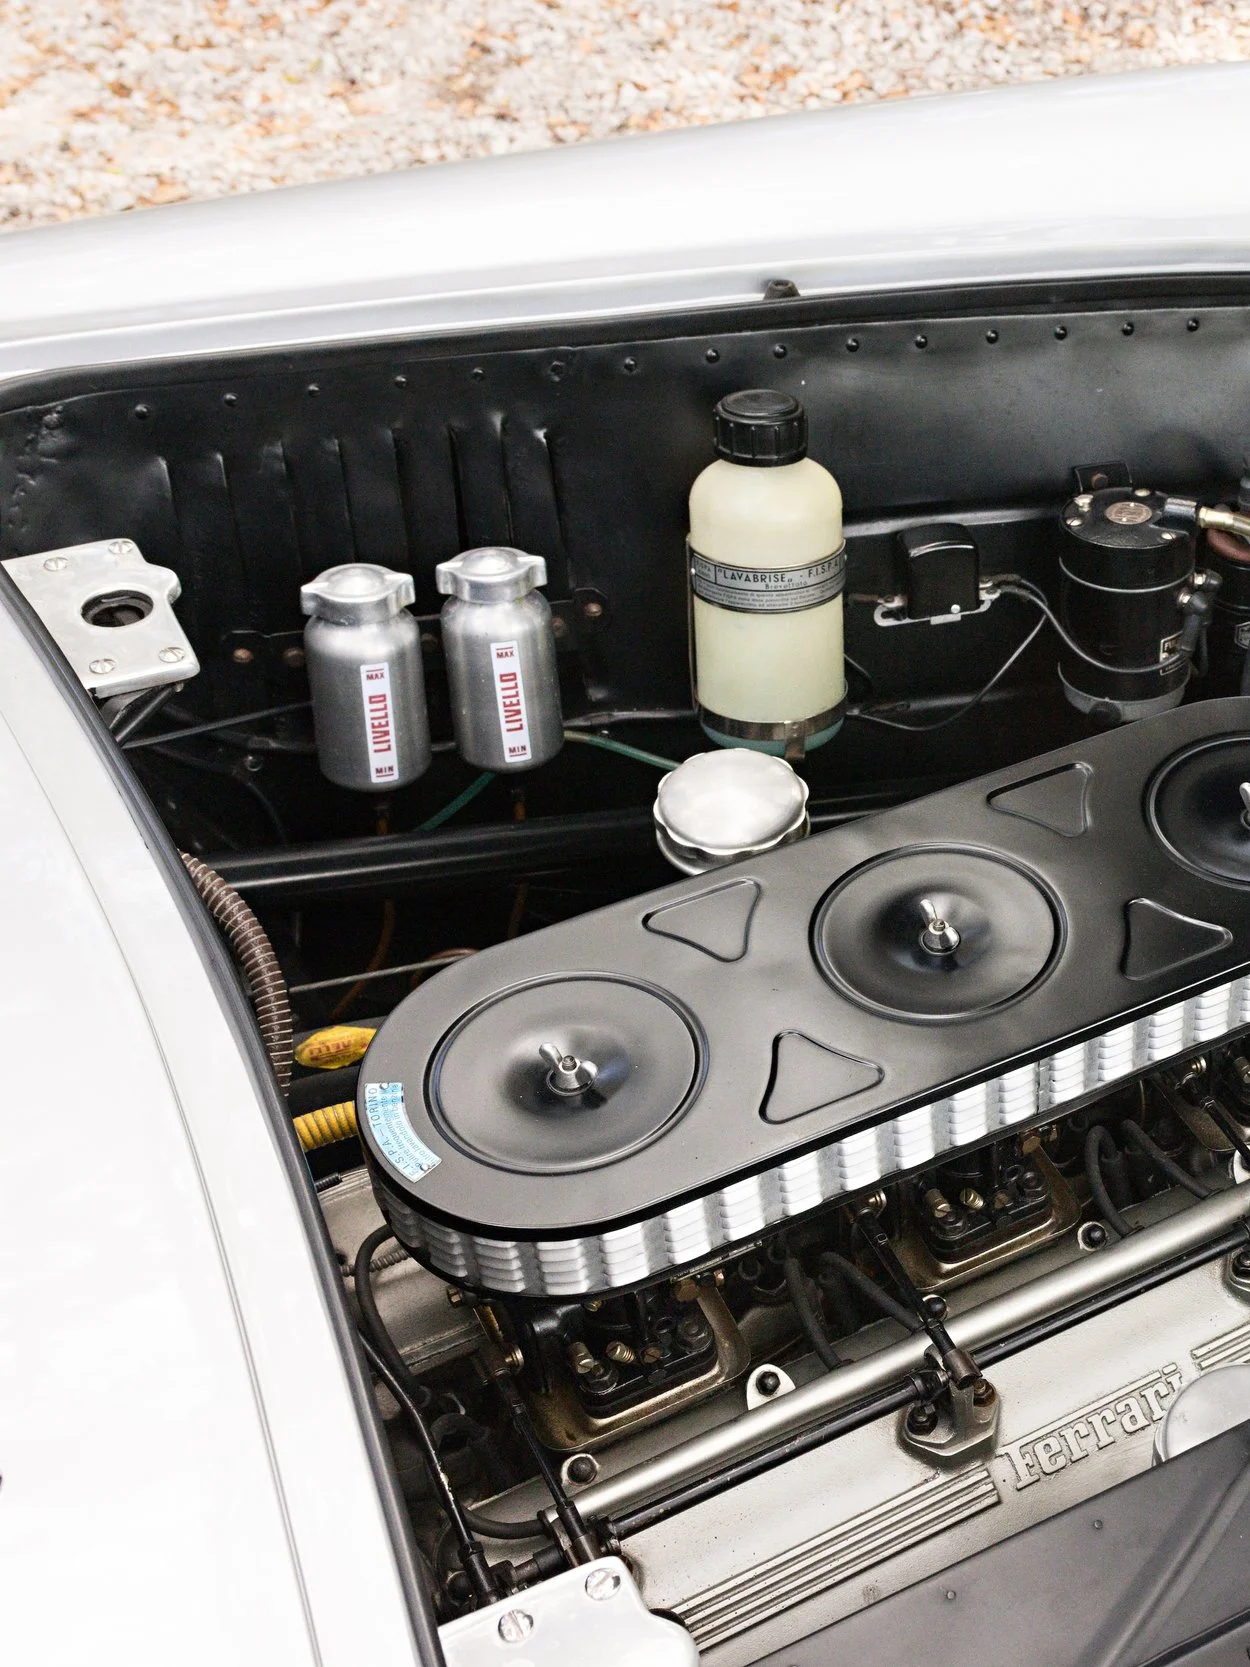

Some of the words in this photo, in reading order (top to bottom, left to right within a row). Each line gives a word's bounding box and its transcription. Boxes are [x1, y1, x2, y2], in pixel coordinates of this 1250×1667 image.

[496, 651, 515, 659] MAX
[366, 673, 385, 681] MAX
[499, 672, 524, 732] LIVELLO
[368, 694, 391, 753] LIVELLO
[508, 746, 527, 754] MIN
[375, 767, 394, 775] MIN
[368, 1087, 382, 1129] TORINO
[995, 1362, 1184, 1491] Ferrari
